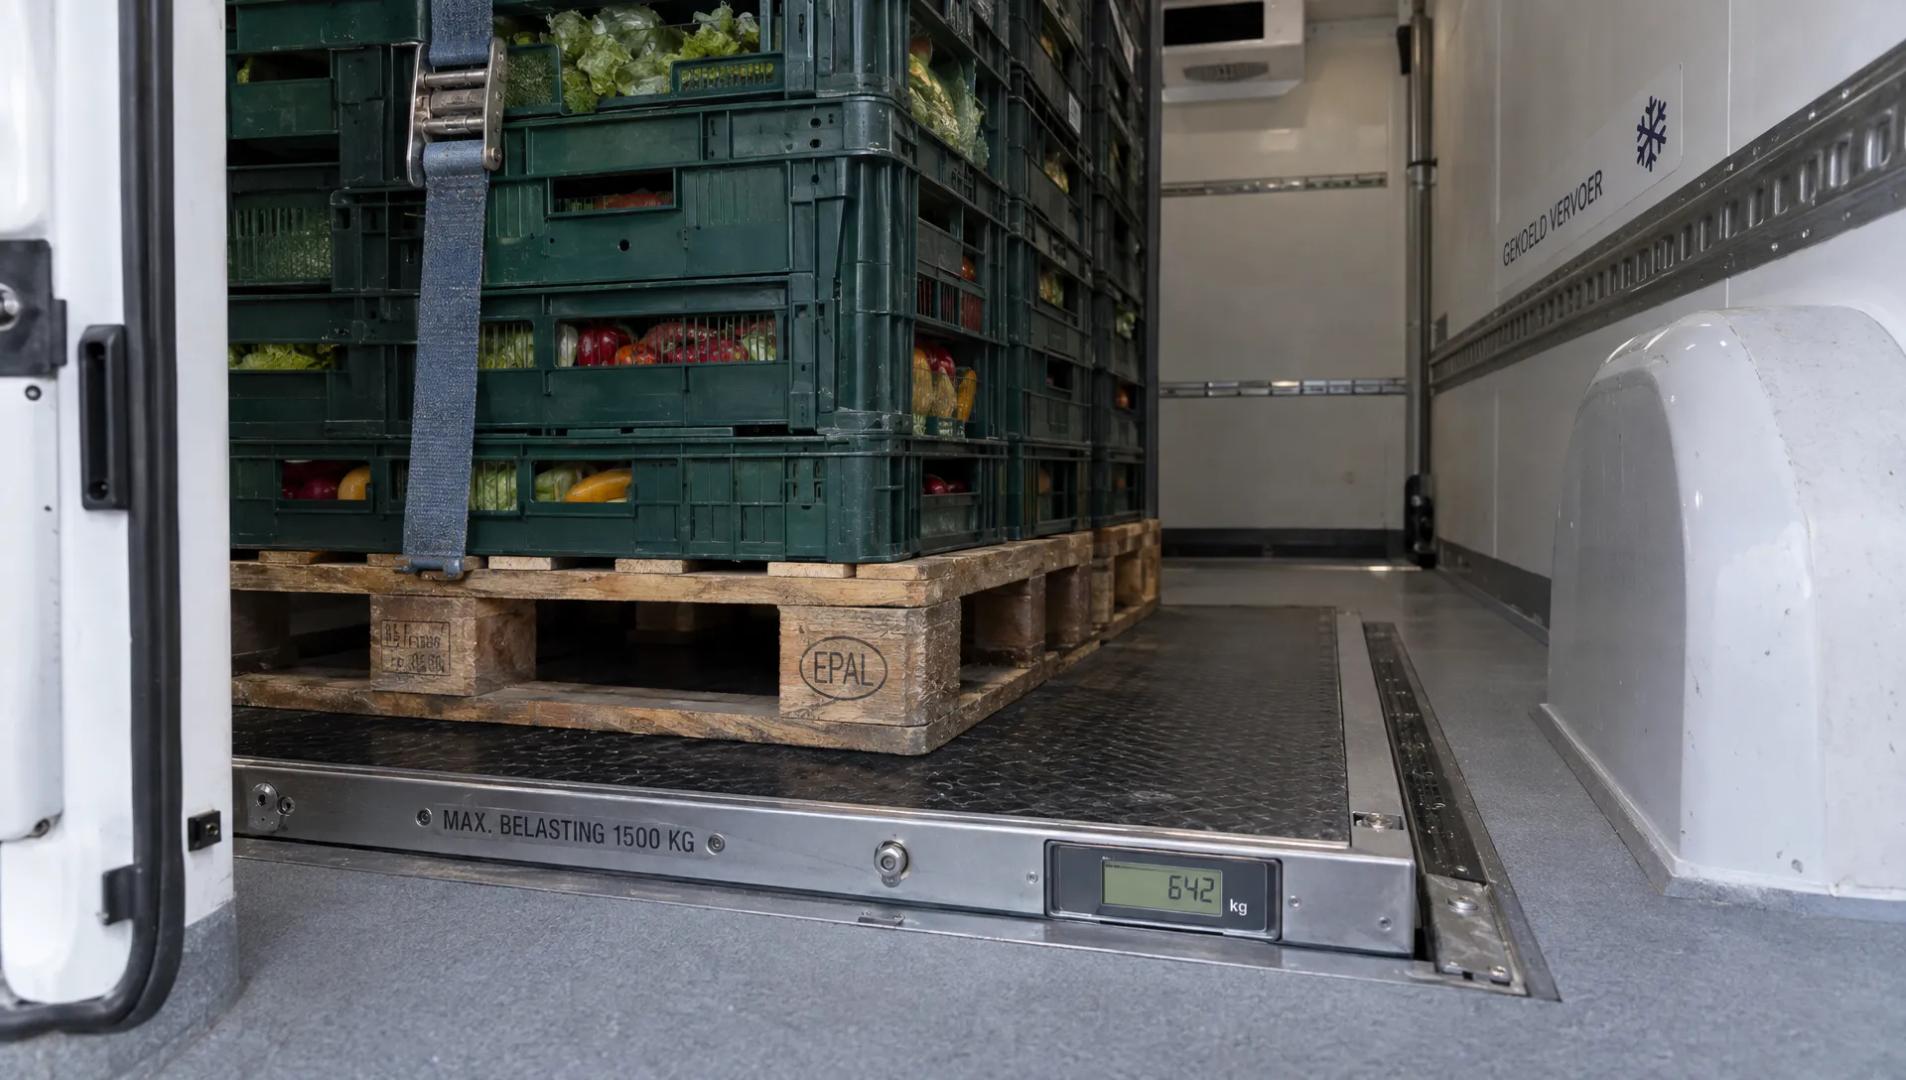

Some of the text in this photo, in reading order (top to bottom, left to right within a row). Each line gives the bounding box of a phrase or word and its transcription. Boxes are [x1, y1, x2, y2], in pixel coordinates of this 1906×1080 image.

[1503, 169, 1602, 266] GEKOELD VERVOER
[814, 651, 874, 686] EPAL
[443, 809, 695, 852] MAX. BELASTING 1500 KG
[1168, 875, 1247, 916] 642 kg
